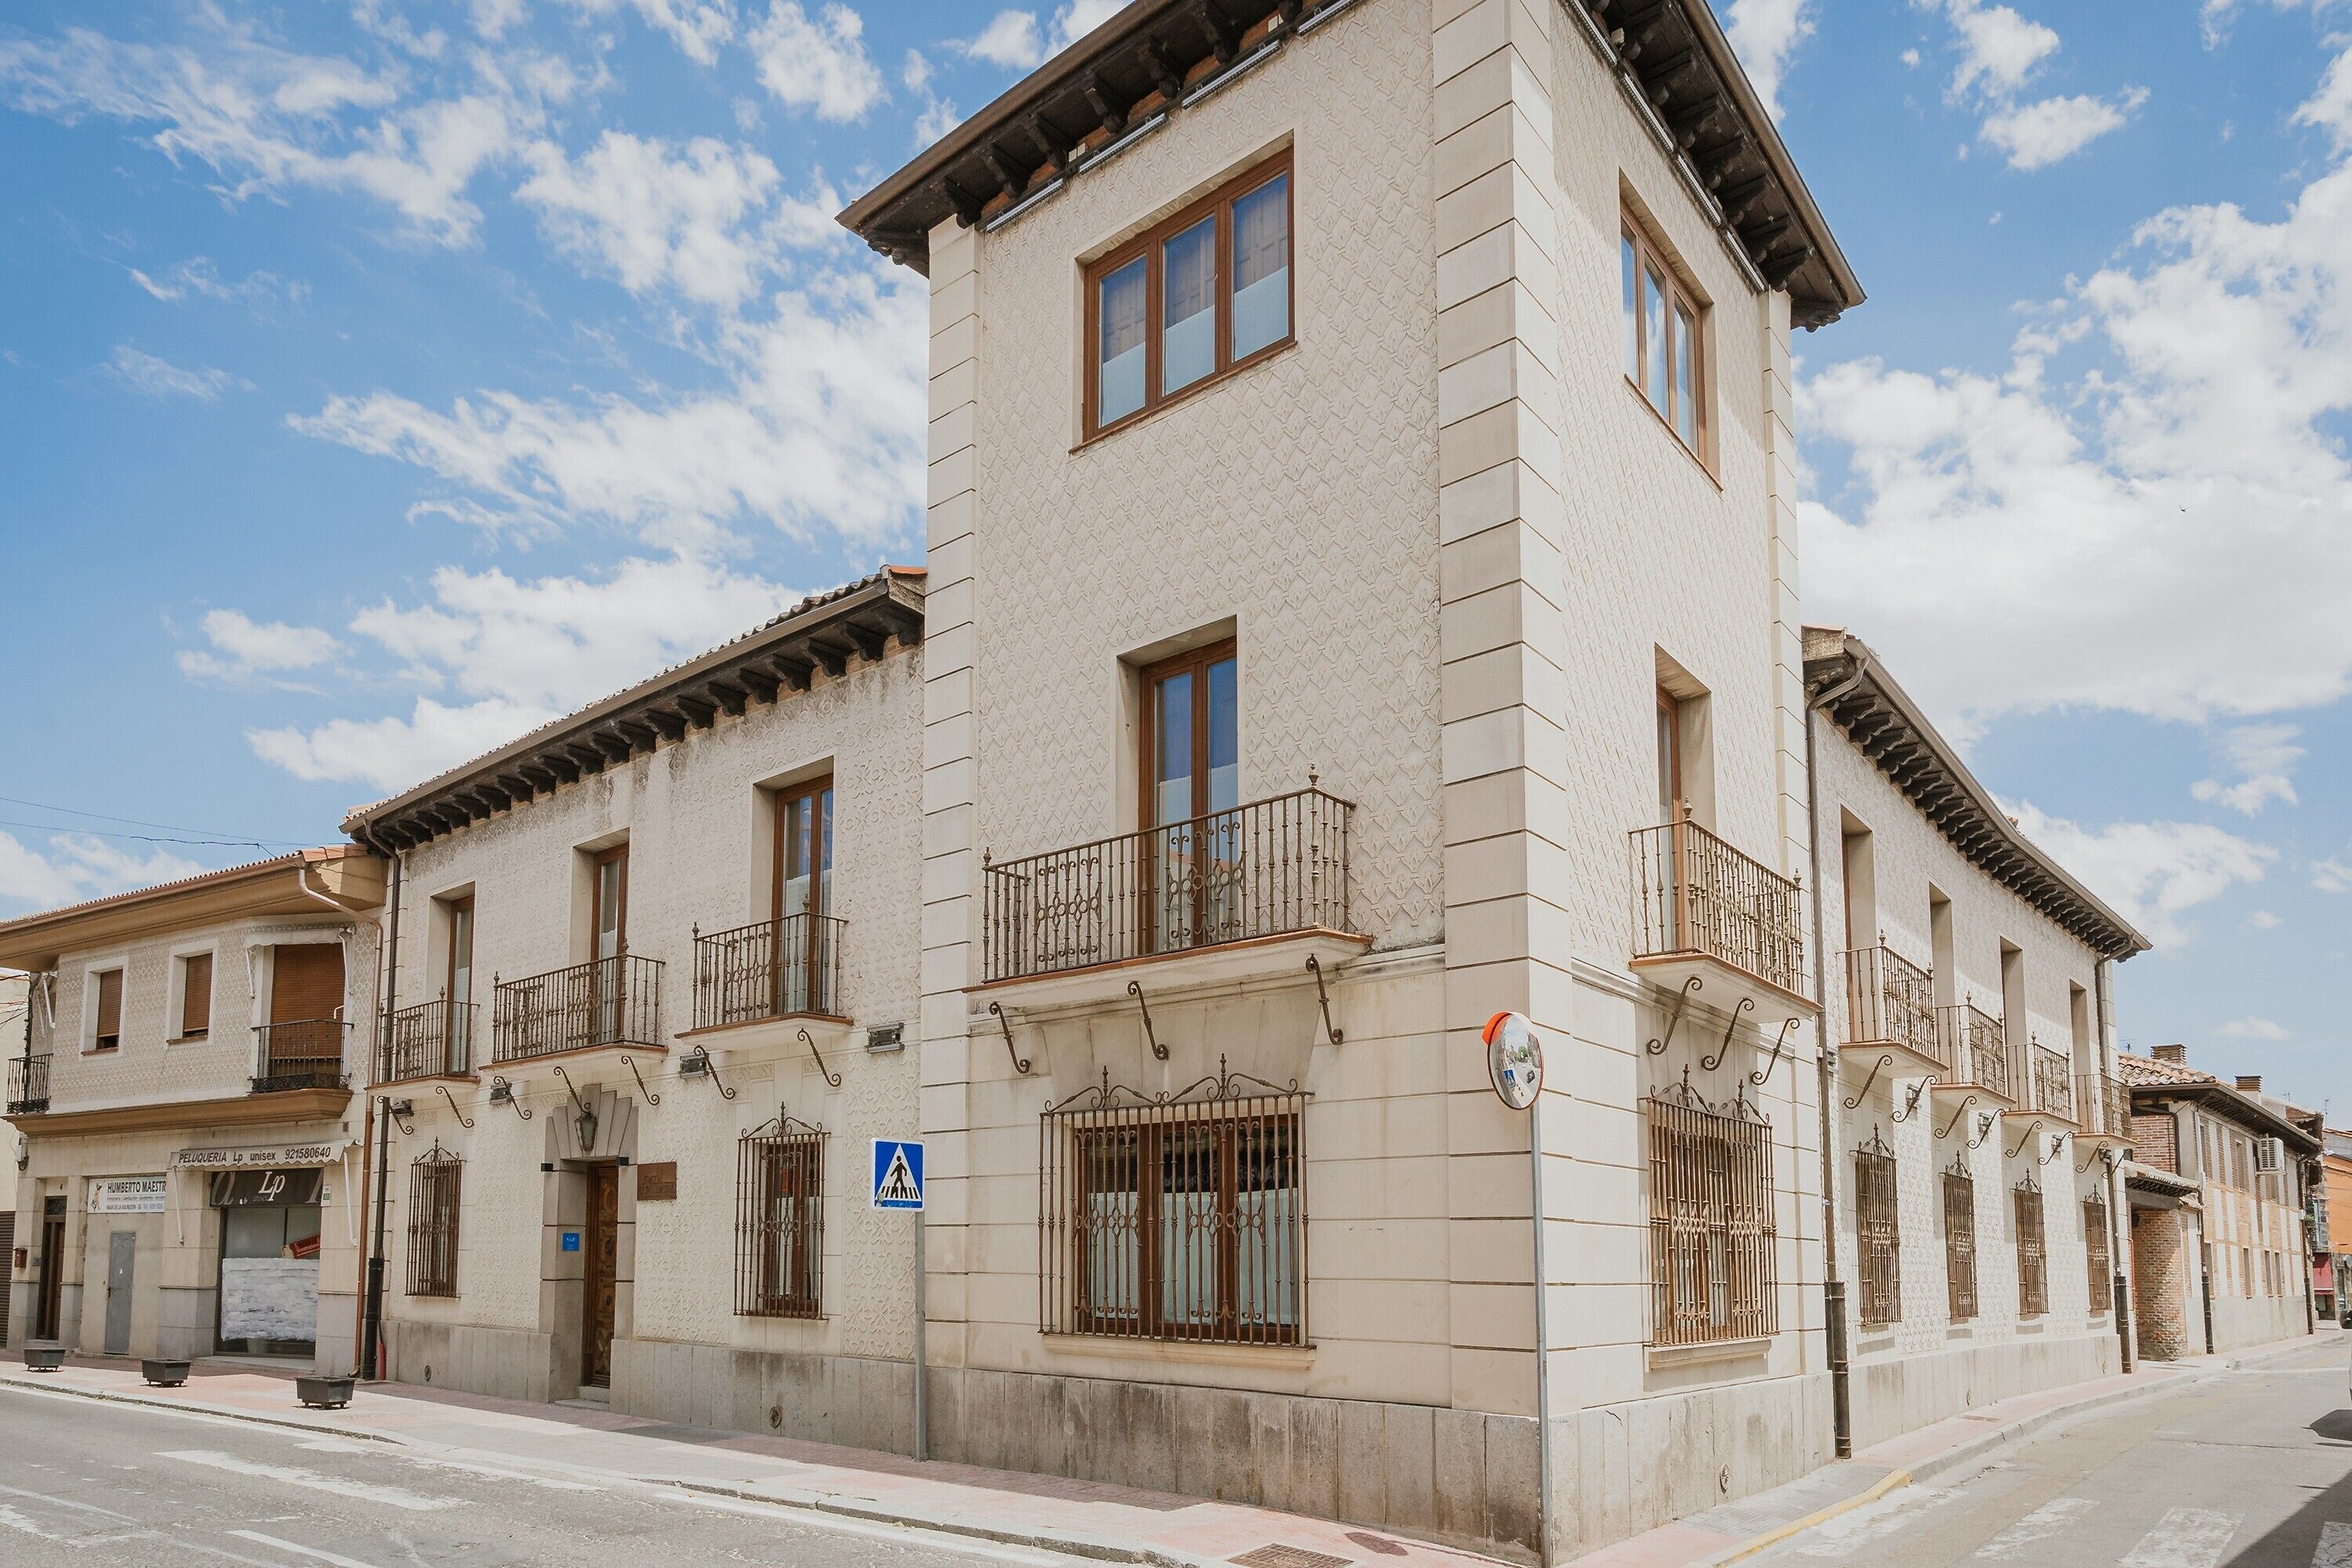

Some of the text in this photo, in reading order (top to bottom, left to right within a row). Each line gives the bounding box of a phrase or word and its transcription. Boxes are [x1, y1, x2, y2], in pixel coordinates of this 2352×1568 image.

[179, 1146, 331, 1163] PELUQUERIA Lp unisex 921580640
[107, 1181, 141, 1193] HUMBERTO
[258, 1171, 285, 1202] Lp
